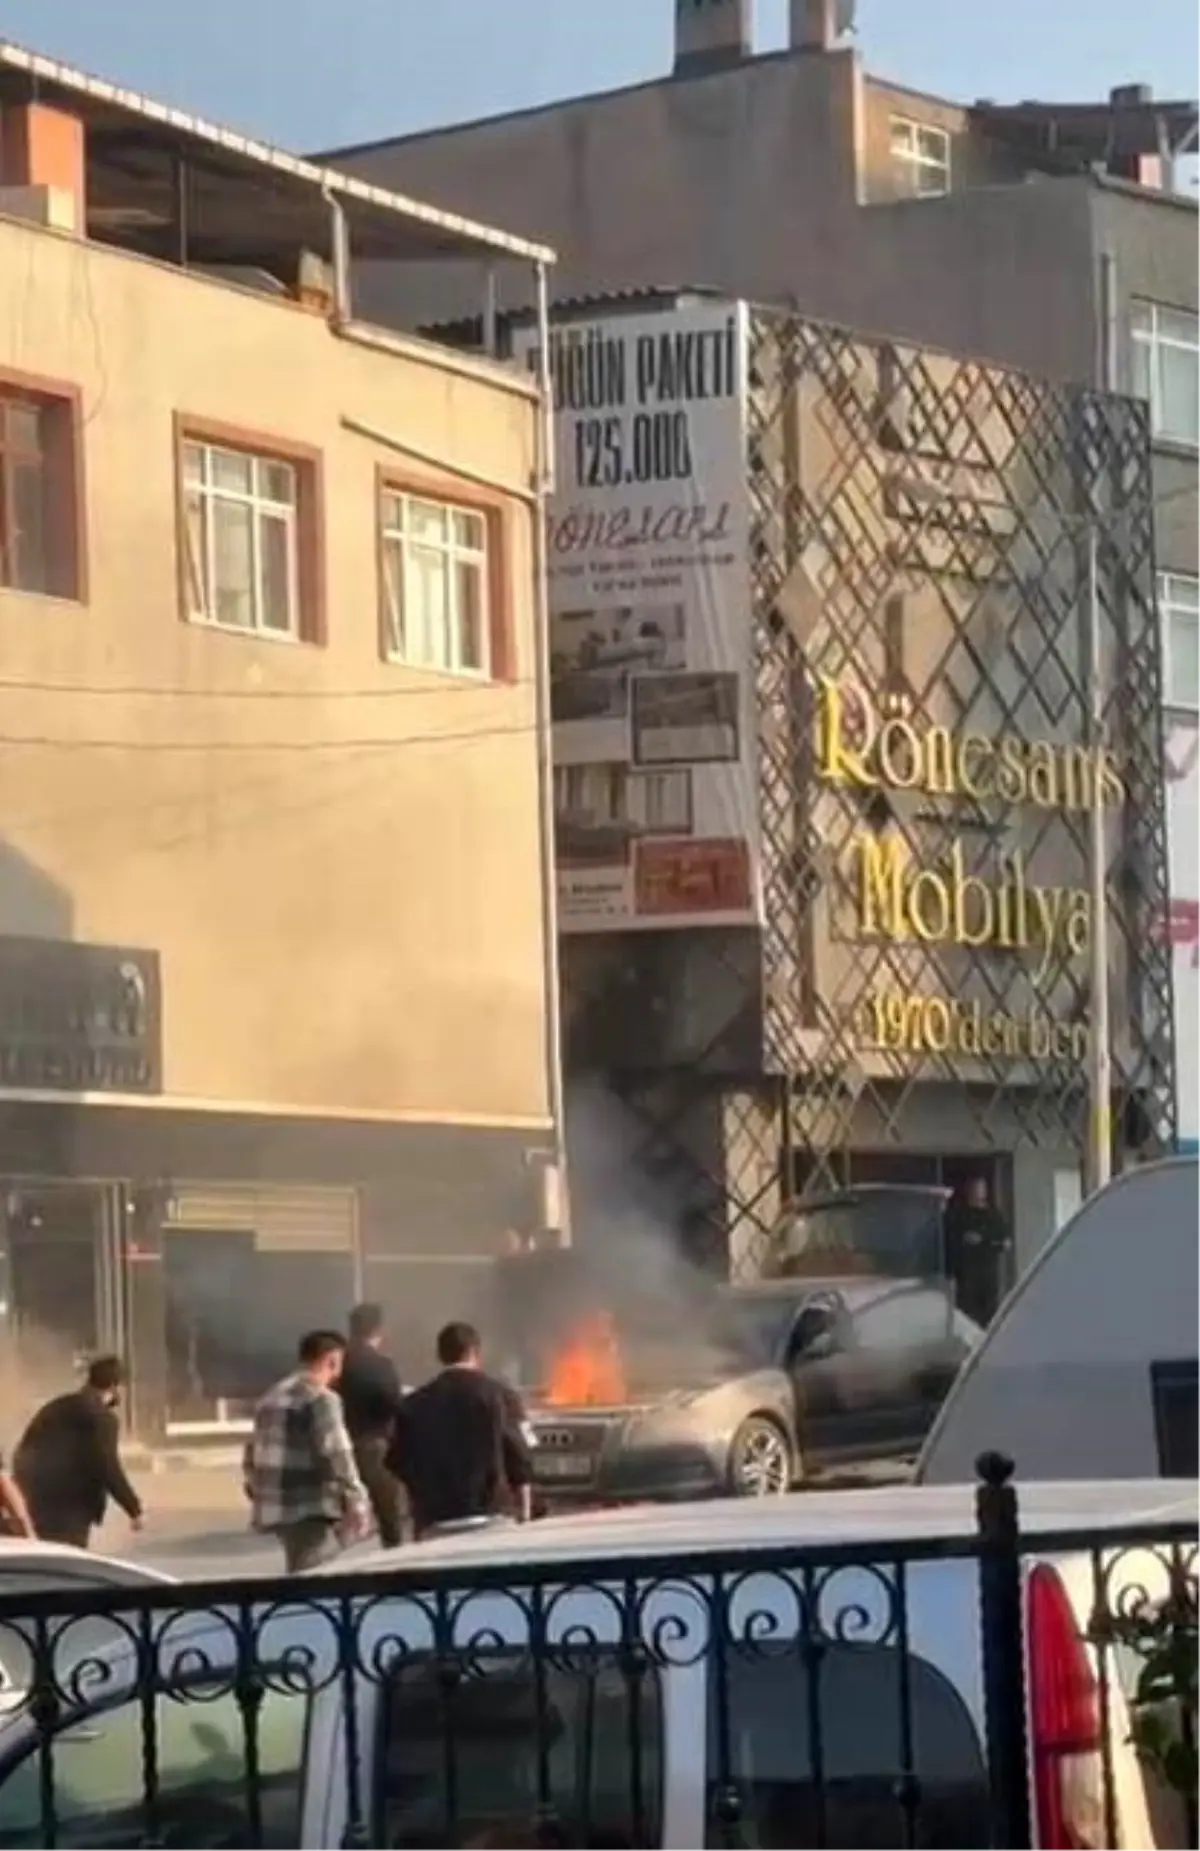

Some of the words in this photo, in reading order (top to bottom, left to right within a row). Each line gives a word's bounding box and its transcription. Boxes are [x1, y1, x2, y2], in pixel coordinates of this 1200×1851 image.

[636, 317, 735, 404] PAKETİ
[575, 410, 692, 488] 125.000
[816, 672, 1126, 810] Rönesans
[860, 830, 1092, 986] Mobilya
